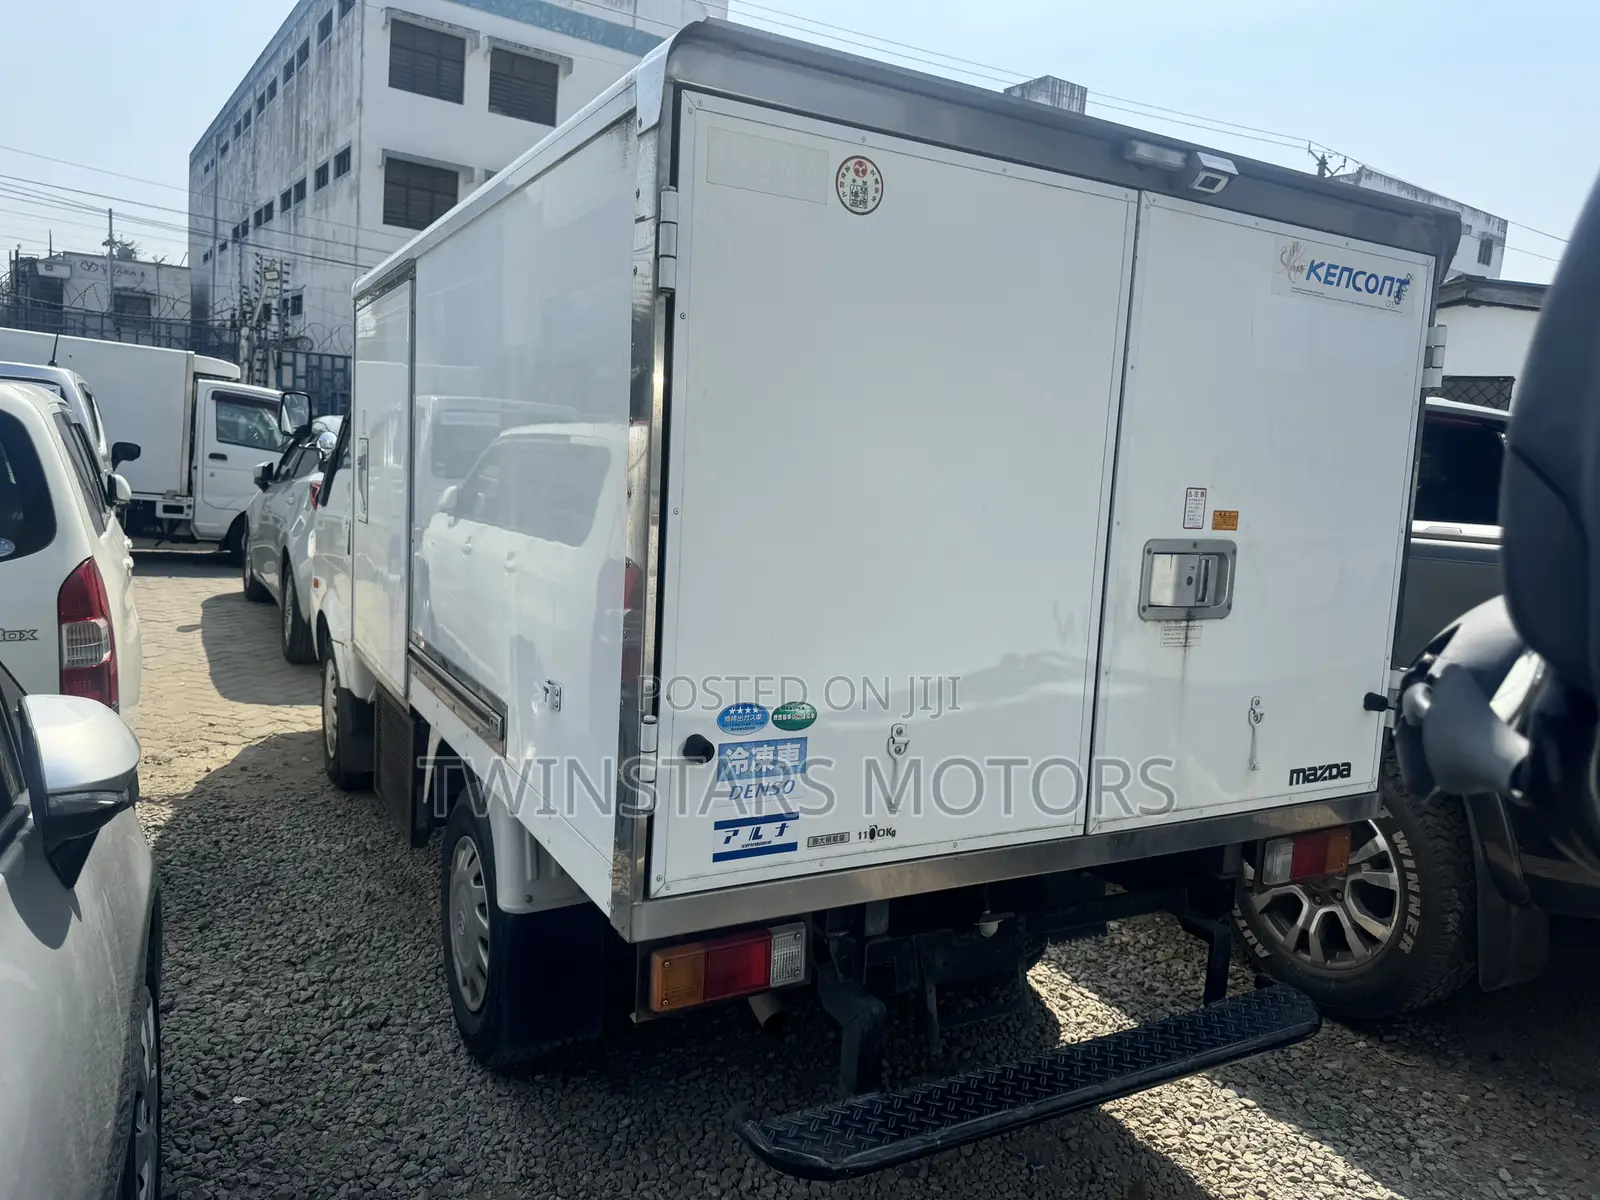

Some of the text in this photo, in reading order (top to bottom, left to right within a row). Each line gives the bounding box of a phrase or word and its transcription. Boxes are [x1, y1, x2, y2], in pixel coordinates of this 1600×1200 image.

[725, 742, 801, 775] 冷凍車
[729, 779, 796, 800] DENSO
[723, 822, 790, 845] アルナ
[1392, 830, 1421, 955] WINNER
